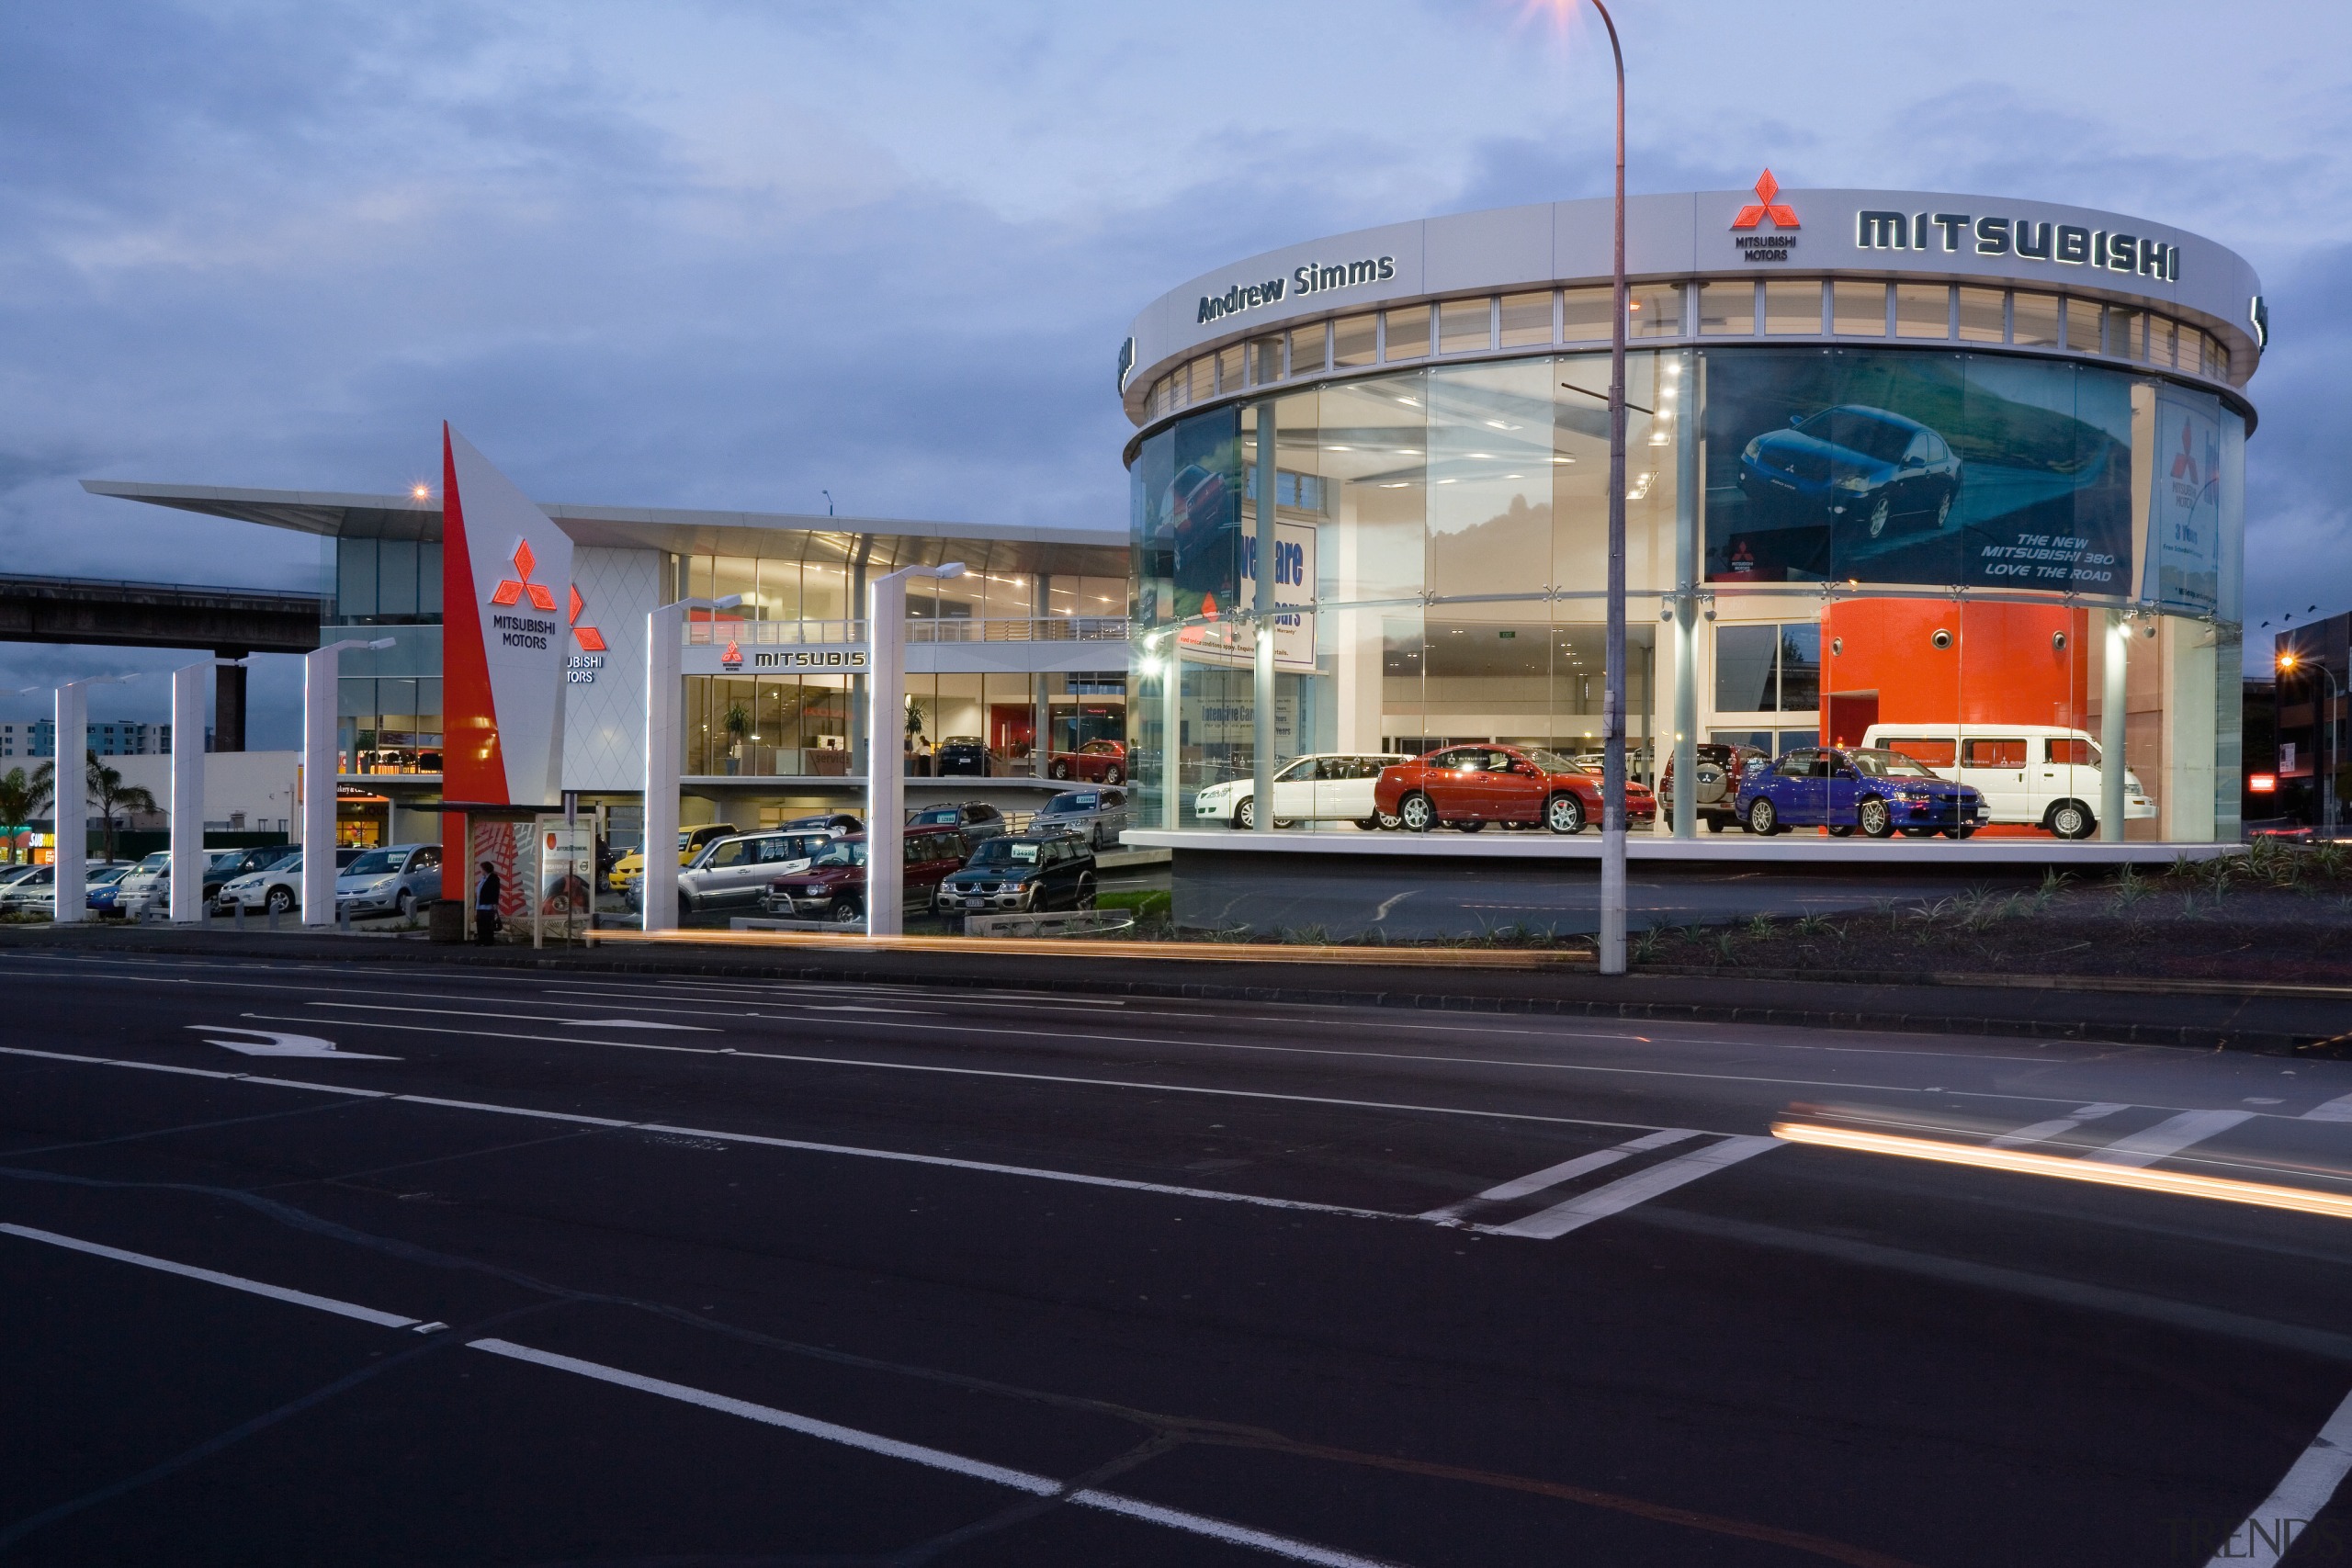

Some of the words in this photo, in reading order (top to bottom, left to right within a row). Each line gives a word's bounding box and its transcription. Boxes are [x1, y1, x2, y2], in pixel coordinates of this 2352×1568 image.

[1736, 236, 1796, 249] MITSUBISHI
[1857, 210, 2180, 282] MITSUBISHI
[1745, 249, 1788, 262] MOTORS
[1197, 277, 1285, 324] Andrew
[1294, 256, 1395, 296] Simms
[2018, 534, 2050, 547] THE
[2052, 536, 2088, 549] NEW
[1981, 546, 2082, 562] MITSUBISHI
[2084, 553, 2114, 565] 380
[1984, 563, 2031, 576] LOVE
[2036, 566, 2067, 579] THE
[2070, 569, 2112, 581] ROAD
[493, 615, 556, 636] MITSUBISHI
[503, 632, 548, 650] MOTORS
[815, 753, 850, 764] service
[29, 832, 55, 847] SUBWA
